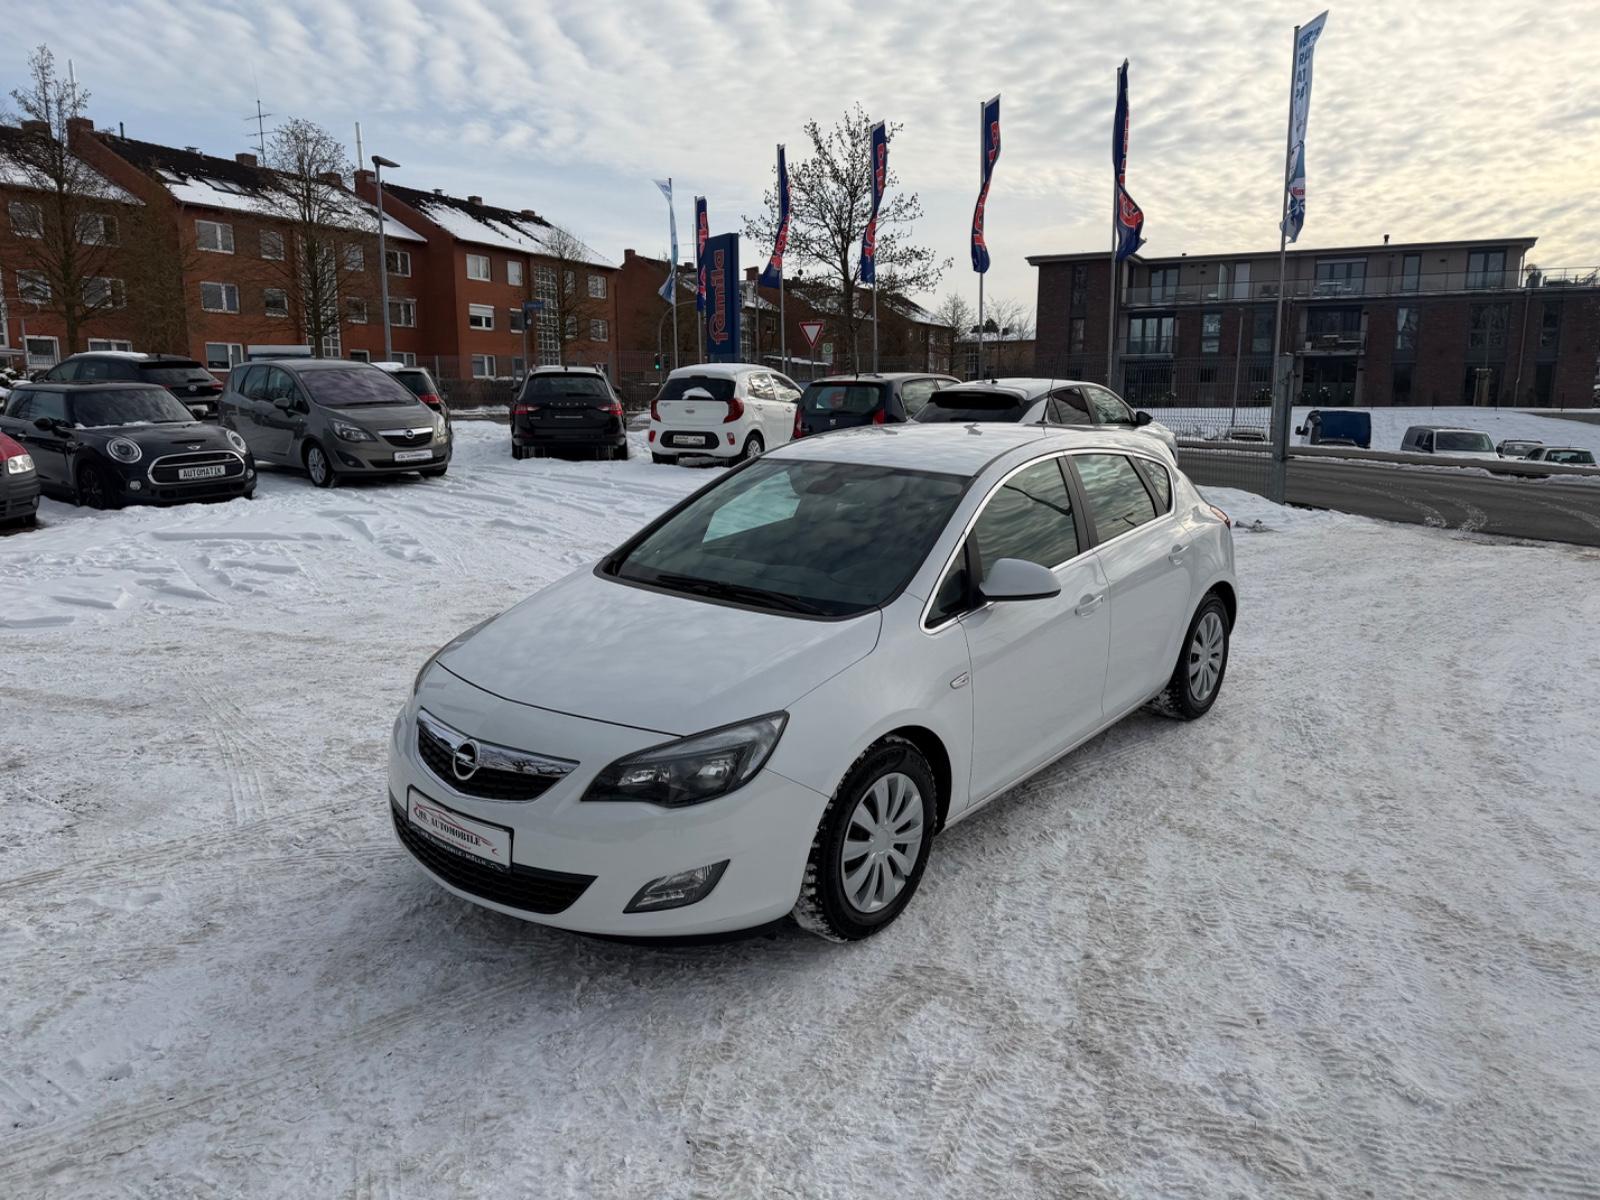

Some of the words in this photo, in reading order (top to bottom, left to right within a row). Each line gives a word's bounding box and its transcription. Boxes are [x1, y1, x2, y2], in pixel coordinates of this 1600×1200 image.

[709, 249, 728, 345] famila
[183, 466, 222, 478] AUTOMATIK
[431, 817, 481, 847] AUTOMOBILE
